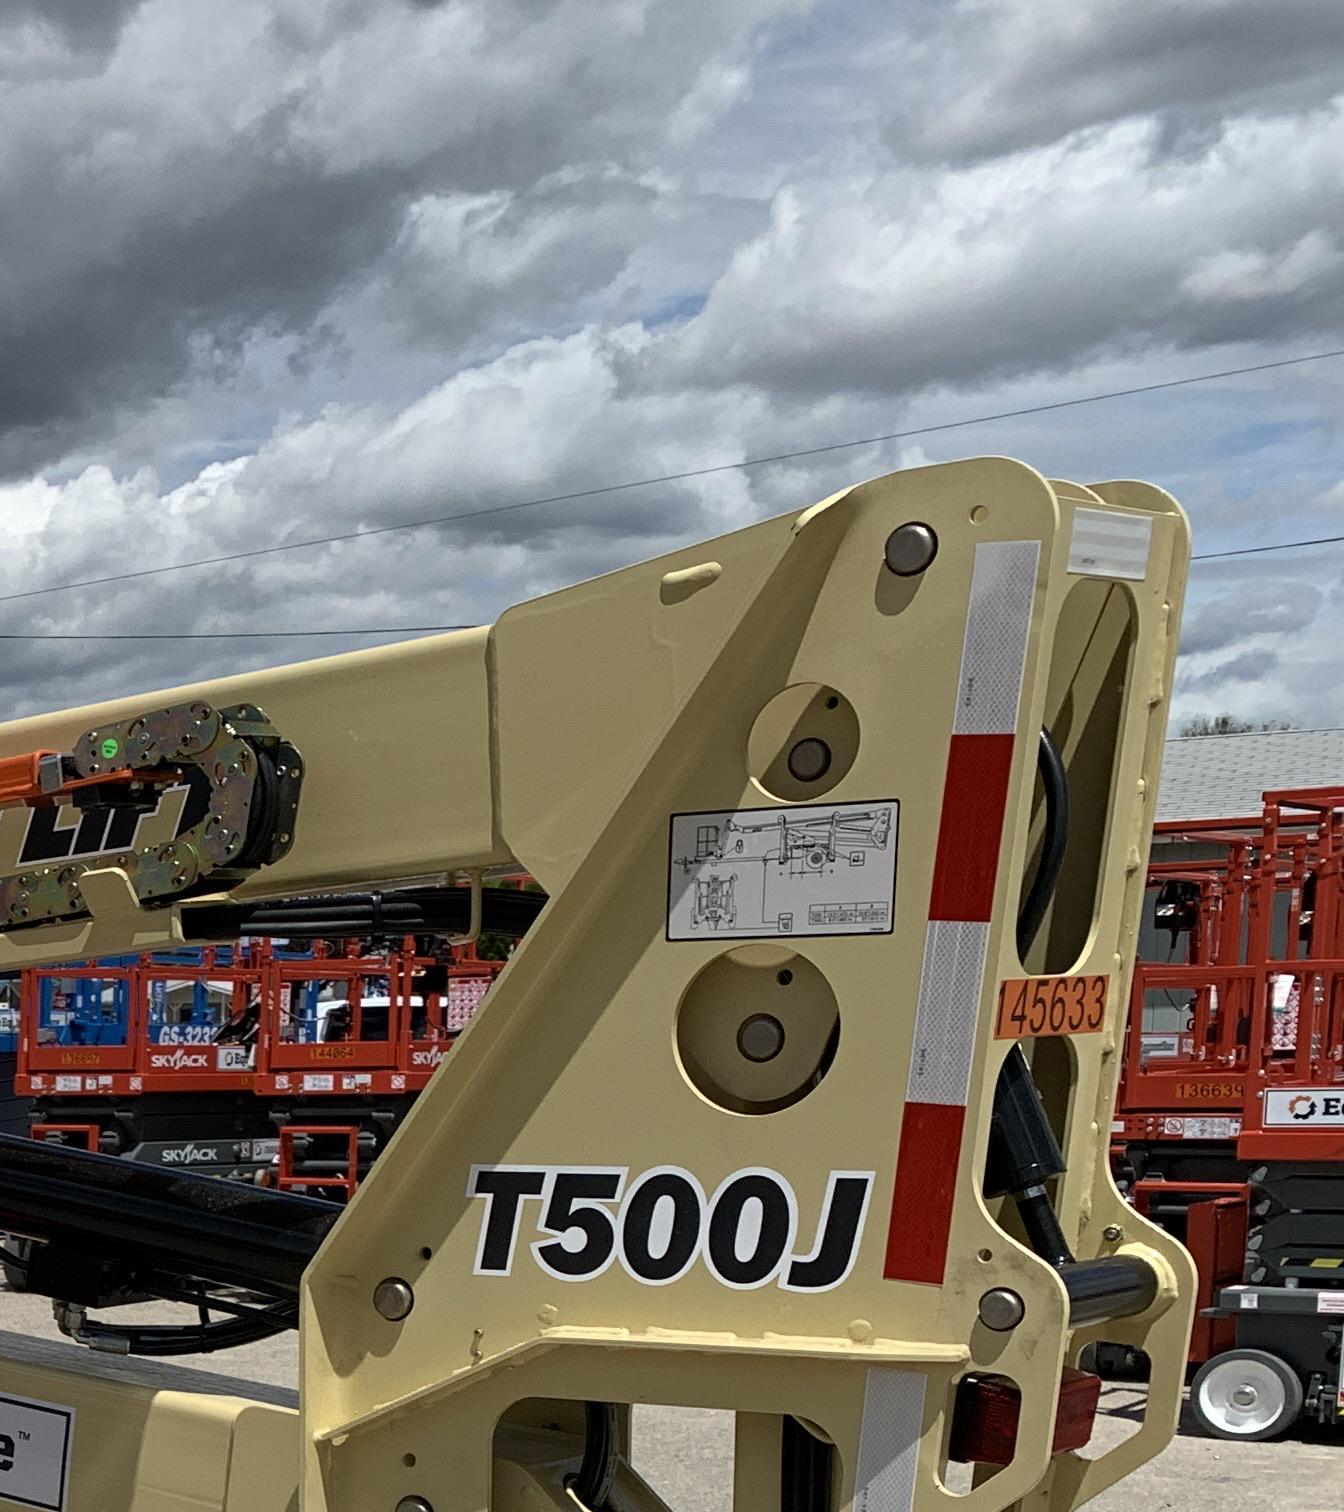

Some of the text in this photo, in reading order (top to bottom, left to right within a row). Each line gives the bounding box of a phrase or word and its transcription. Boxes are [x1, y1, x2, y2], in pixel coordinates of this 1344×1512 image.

[997, 975, 1106, 1036] 145633
[150, 1050, 208, 1070] SKYJACK
[162, 1144, 218, 1164] SKYJACK
[469, 1166, 875, 1292] T500J
